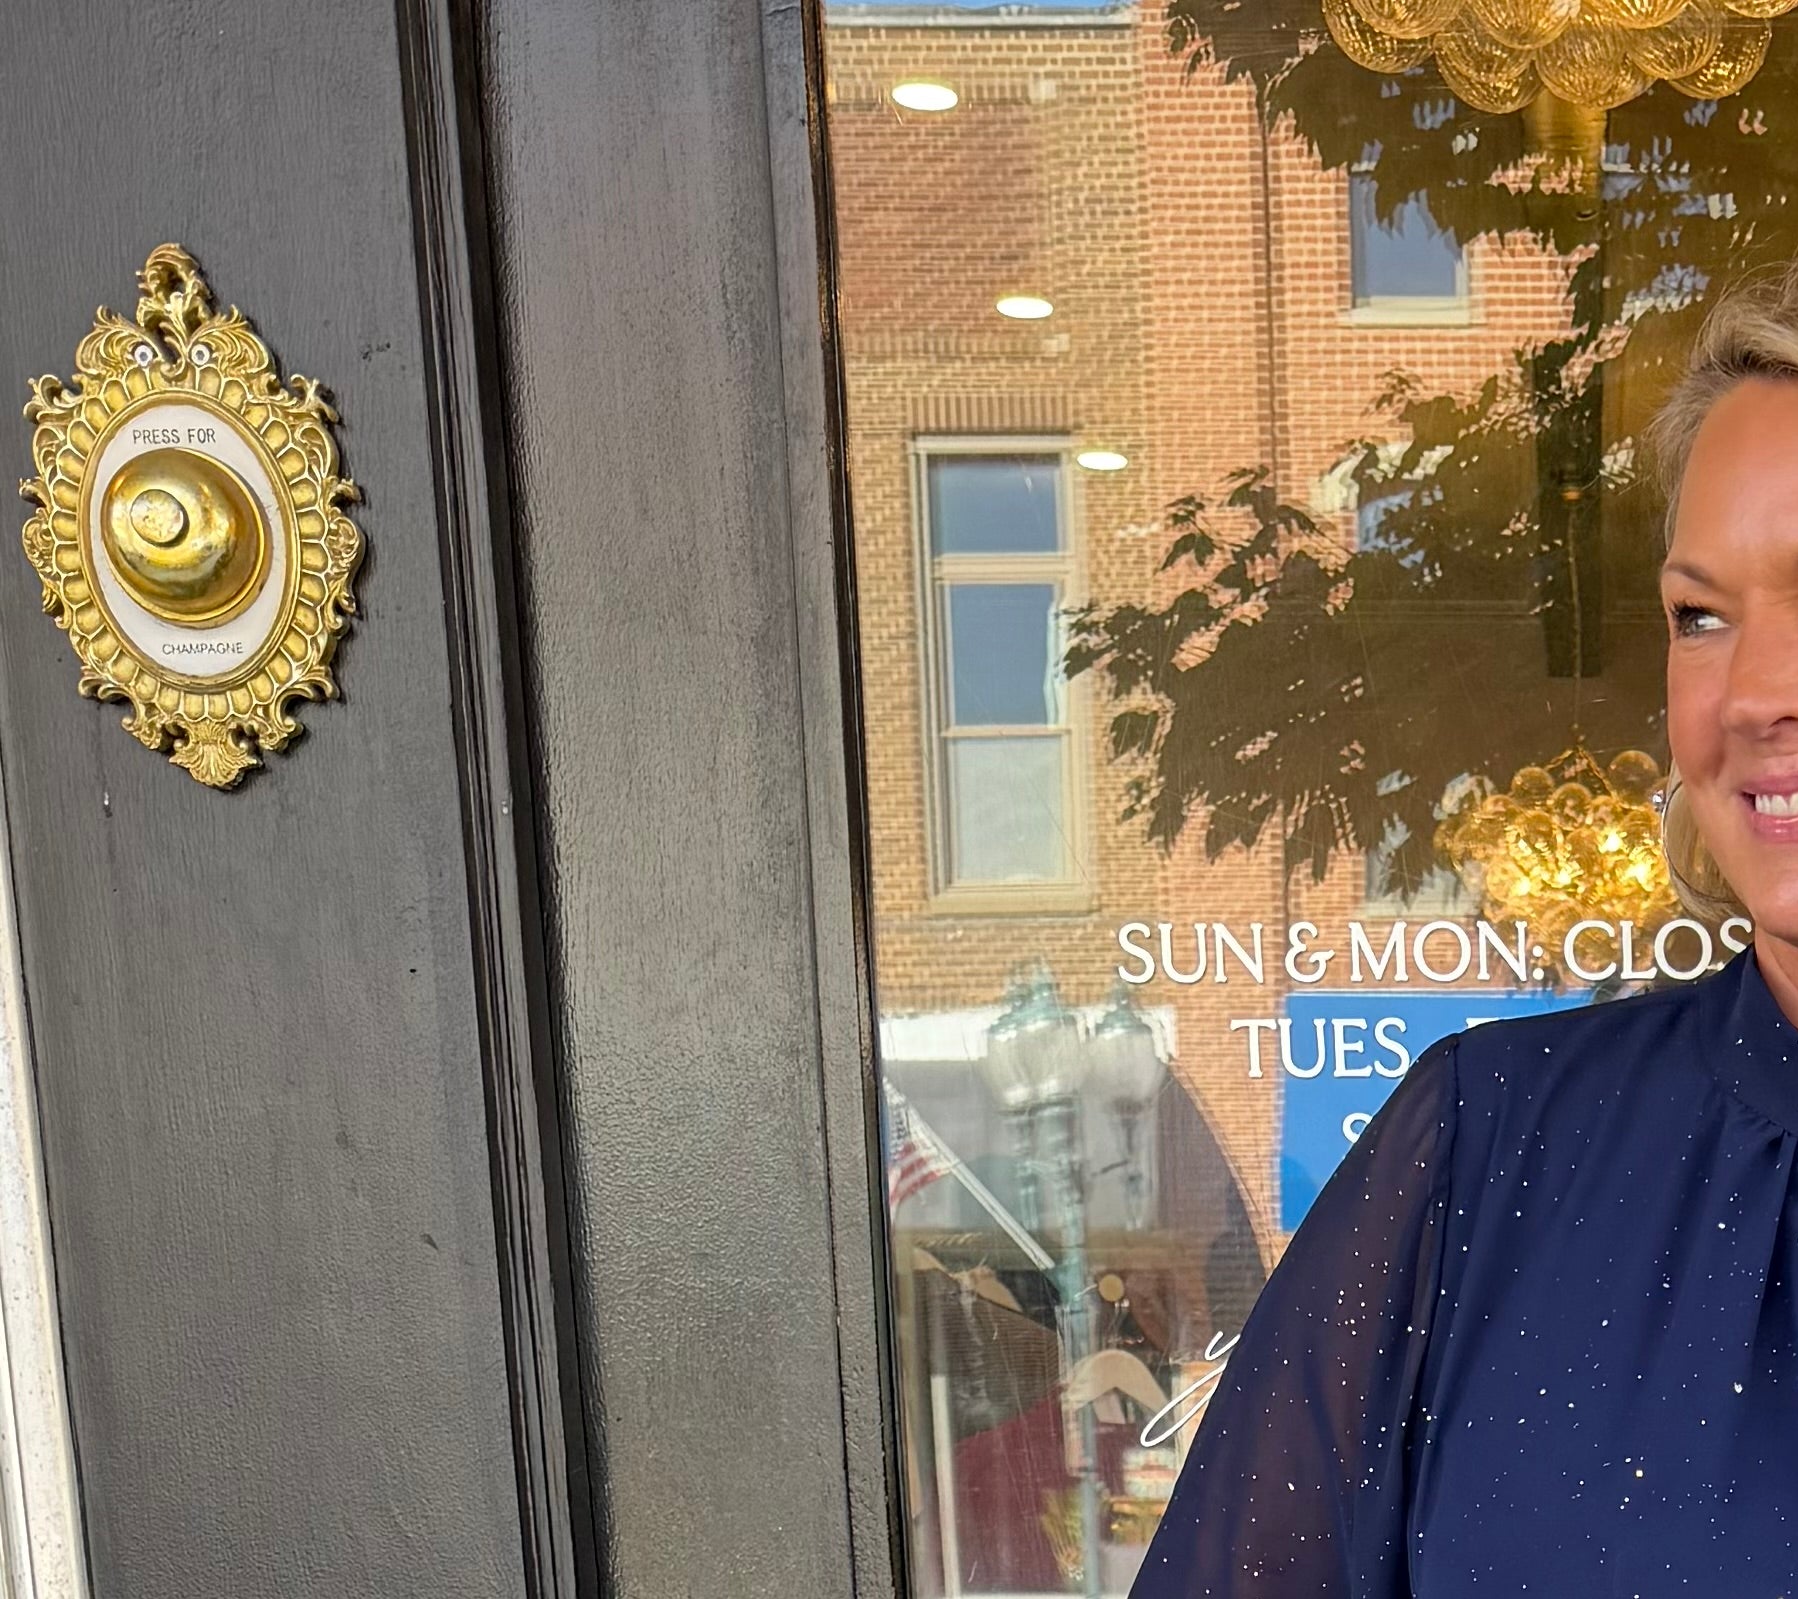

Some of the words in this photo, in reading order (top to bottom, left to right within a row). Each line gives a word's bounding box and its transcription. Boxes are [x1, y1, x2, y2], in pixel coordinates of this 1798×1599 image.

[132, 428, 181, 445] PRESS
[187, 428, 216, 444] FOR
[161, 642, 244, 655] CHAMPAGNE
[1117, 922, 1265, 984] SUN
[1284, 921, 1336, 983] &
[1348, 920, 1546, 983] MON:
[1229, 1017, 1411, 1079] TUES
